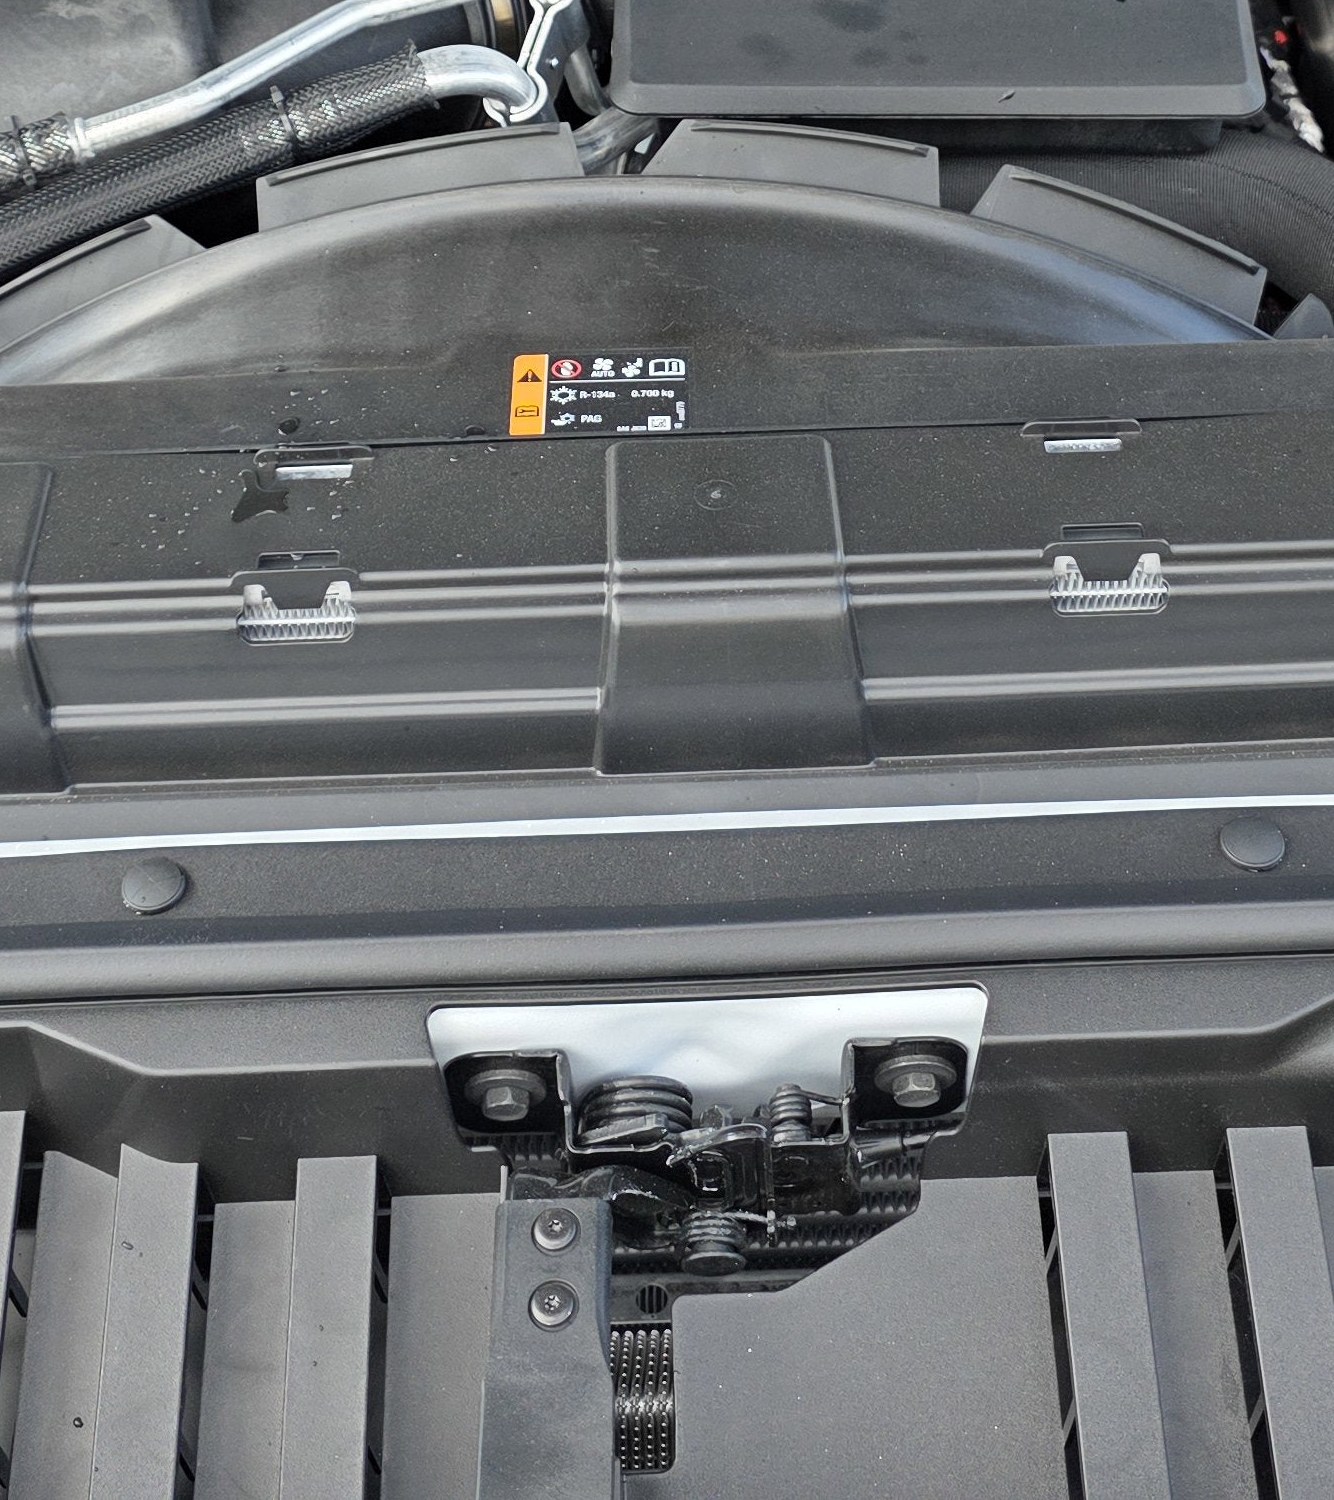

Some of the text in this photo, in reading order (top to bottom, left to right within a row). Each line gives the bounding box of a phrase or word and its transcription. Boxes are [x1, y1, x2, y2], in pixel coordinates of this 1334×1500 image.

[590, 370, 616, 378] AUTO
[579, 389, 675, 399] R-134a 0.700 kg
[580, 414, 603, 423] PAG
